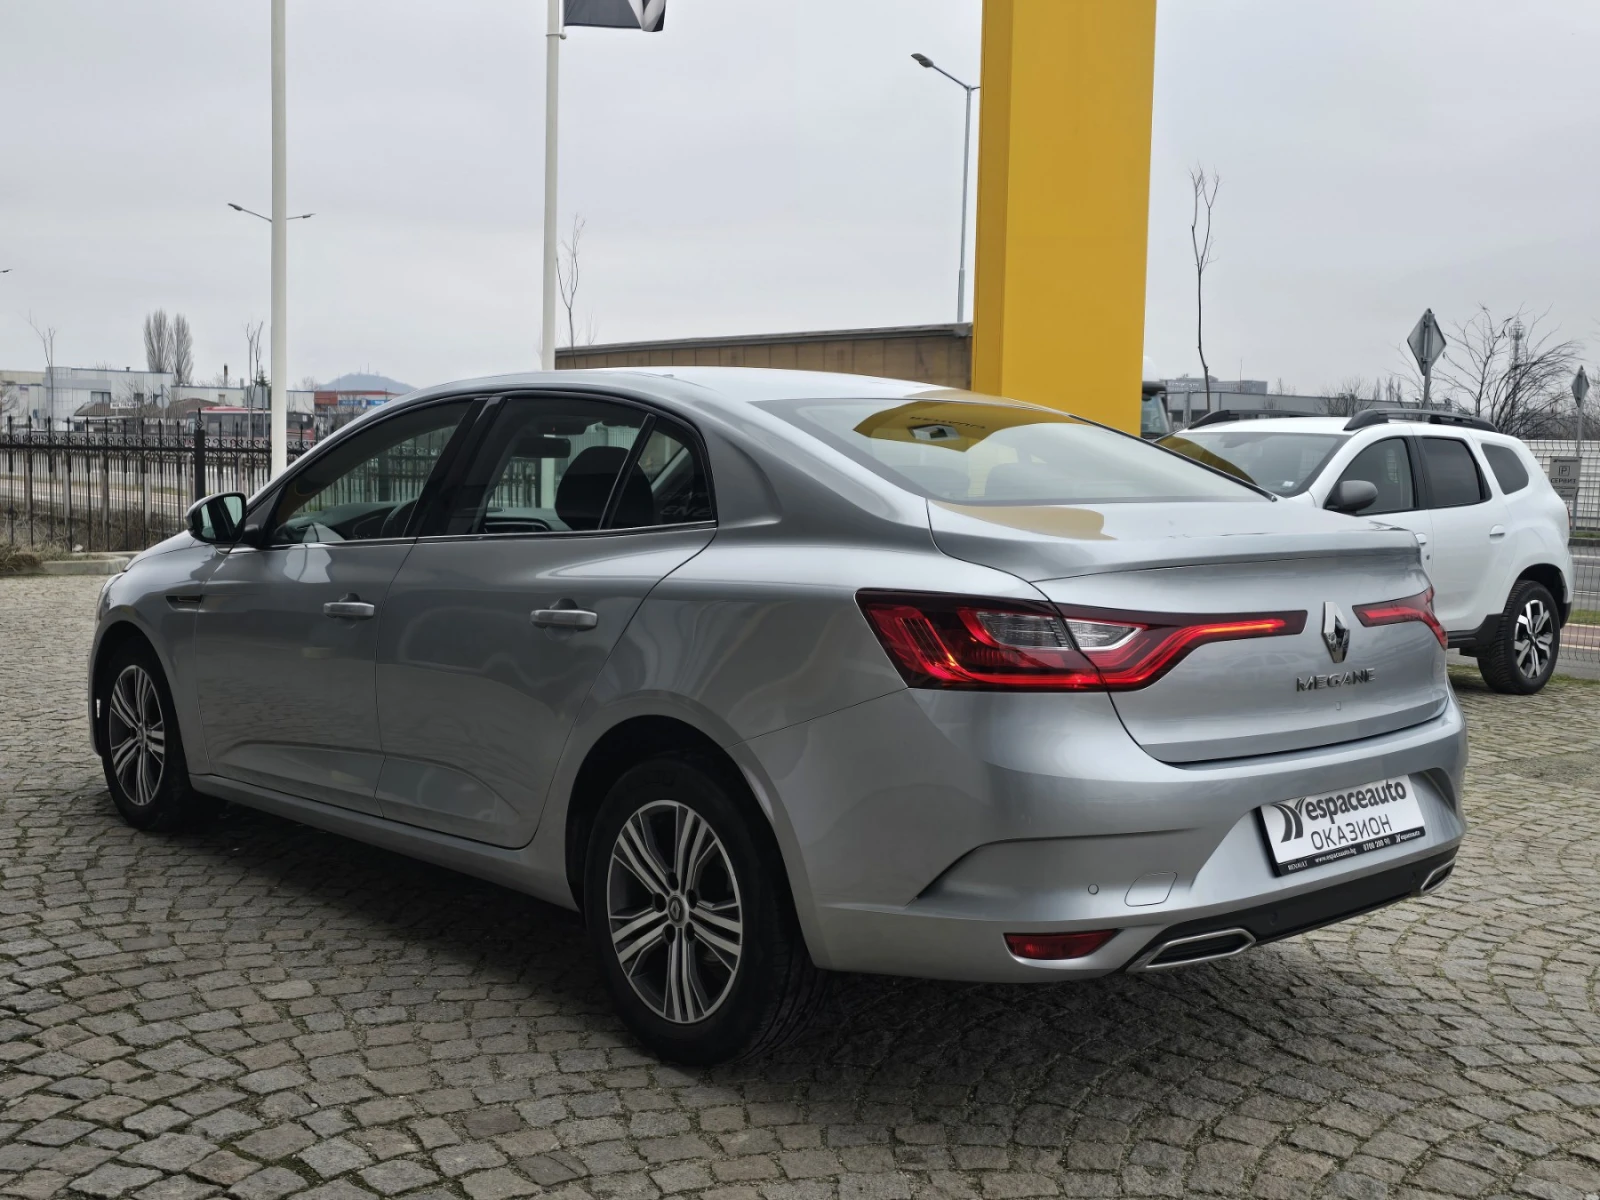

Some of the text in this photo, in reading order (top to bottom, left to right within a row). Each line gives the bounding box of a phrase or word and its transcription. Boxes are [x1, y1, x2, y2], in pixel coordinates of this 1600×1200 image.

[1296, 668, 1376, 692] MEGANE
[1305, 779, 1407, 824] espaceauto
[1310, 813, 1393, 851] ОКАЗИОН
